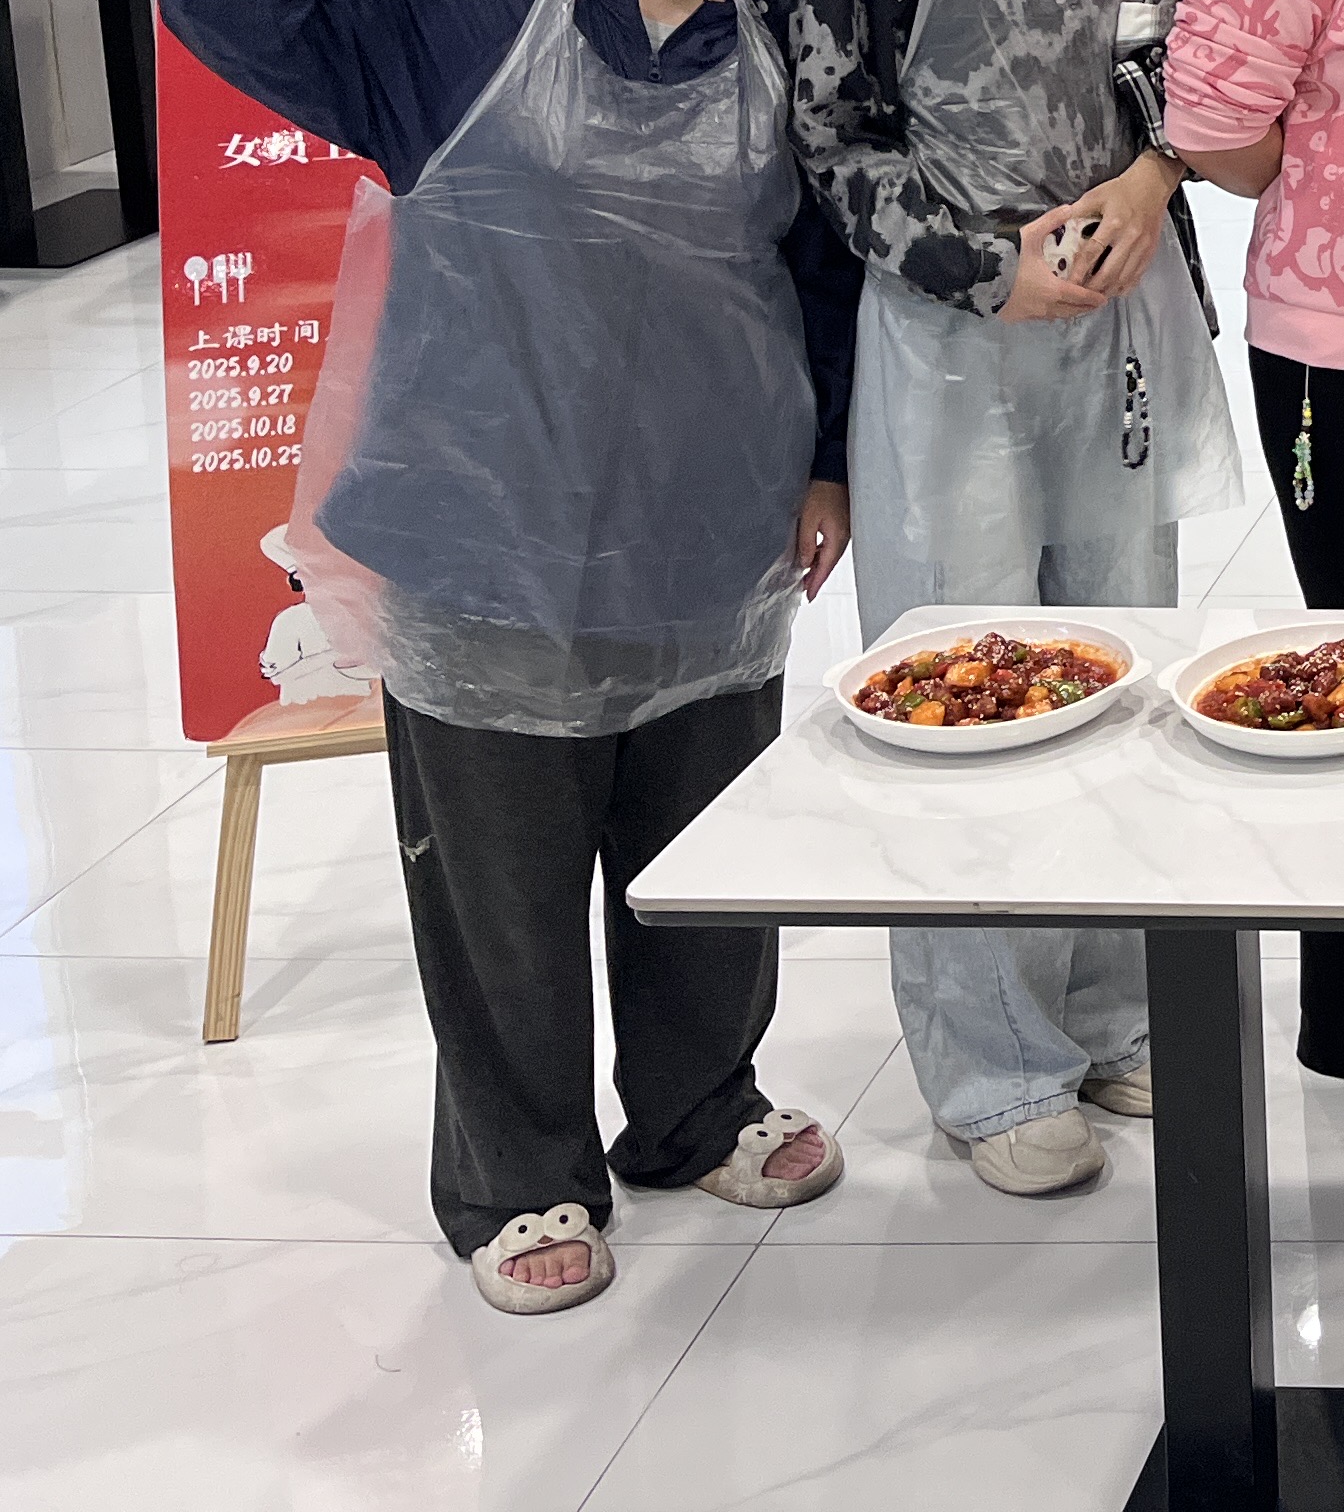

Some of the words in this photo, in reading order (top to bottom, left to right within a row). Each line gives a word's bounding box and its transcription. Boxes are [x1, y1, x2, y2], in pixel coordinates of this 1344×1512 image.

[188, 320, 319, 351] 上课时间
[188, 353, 293, 380] 2025.9.20
[189, 384, 294, 411] 2025.9.27
[191, 414, 296, 442] 2025.10.18
[192, 444, 302, 473] 2025.10.25
